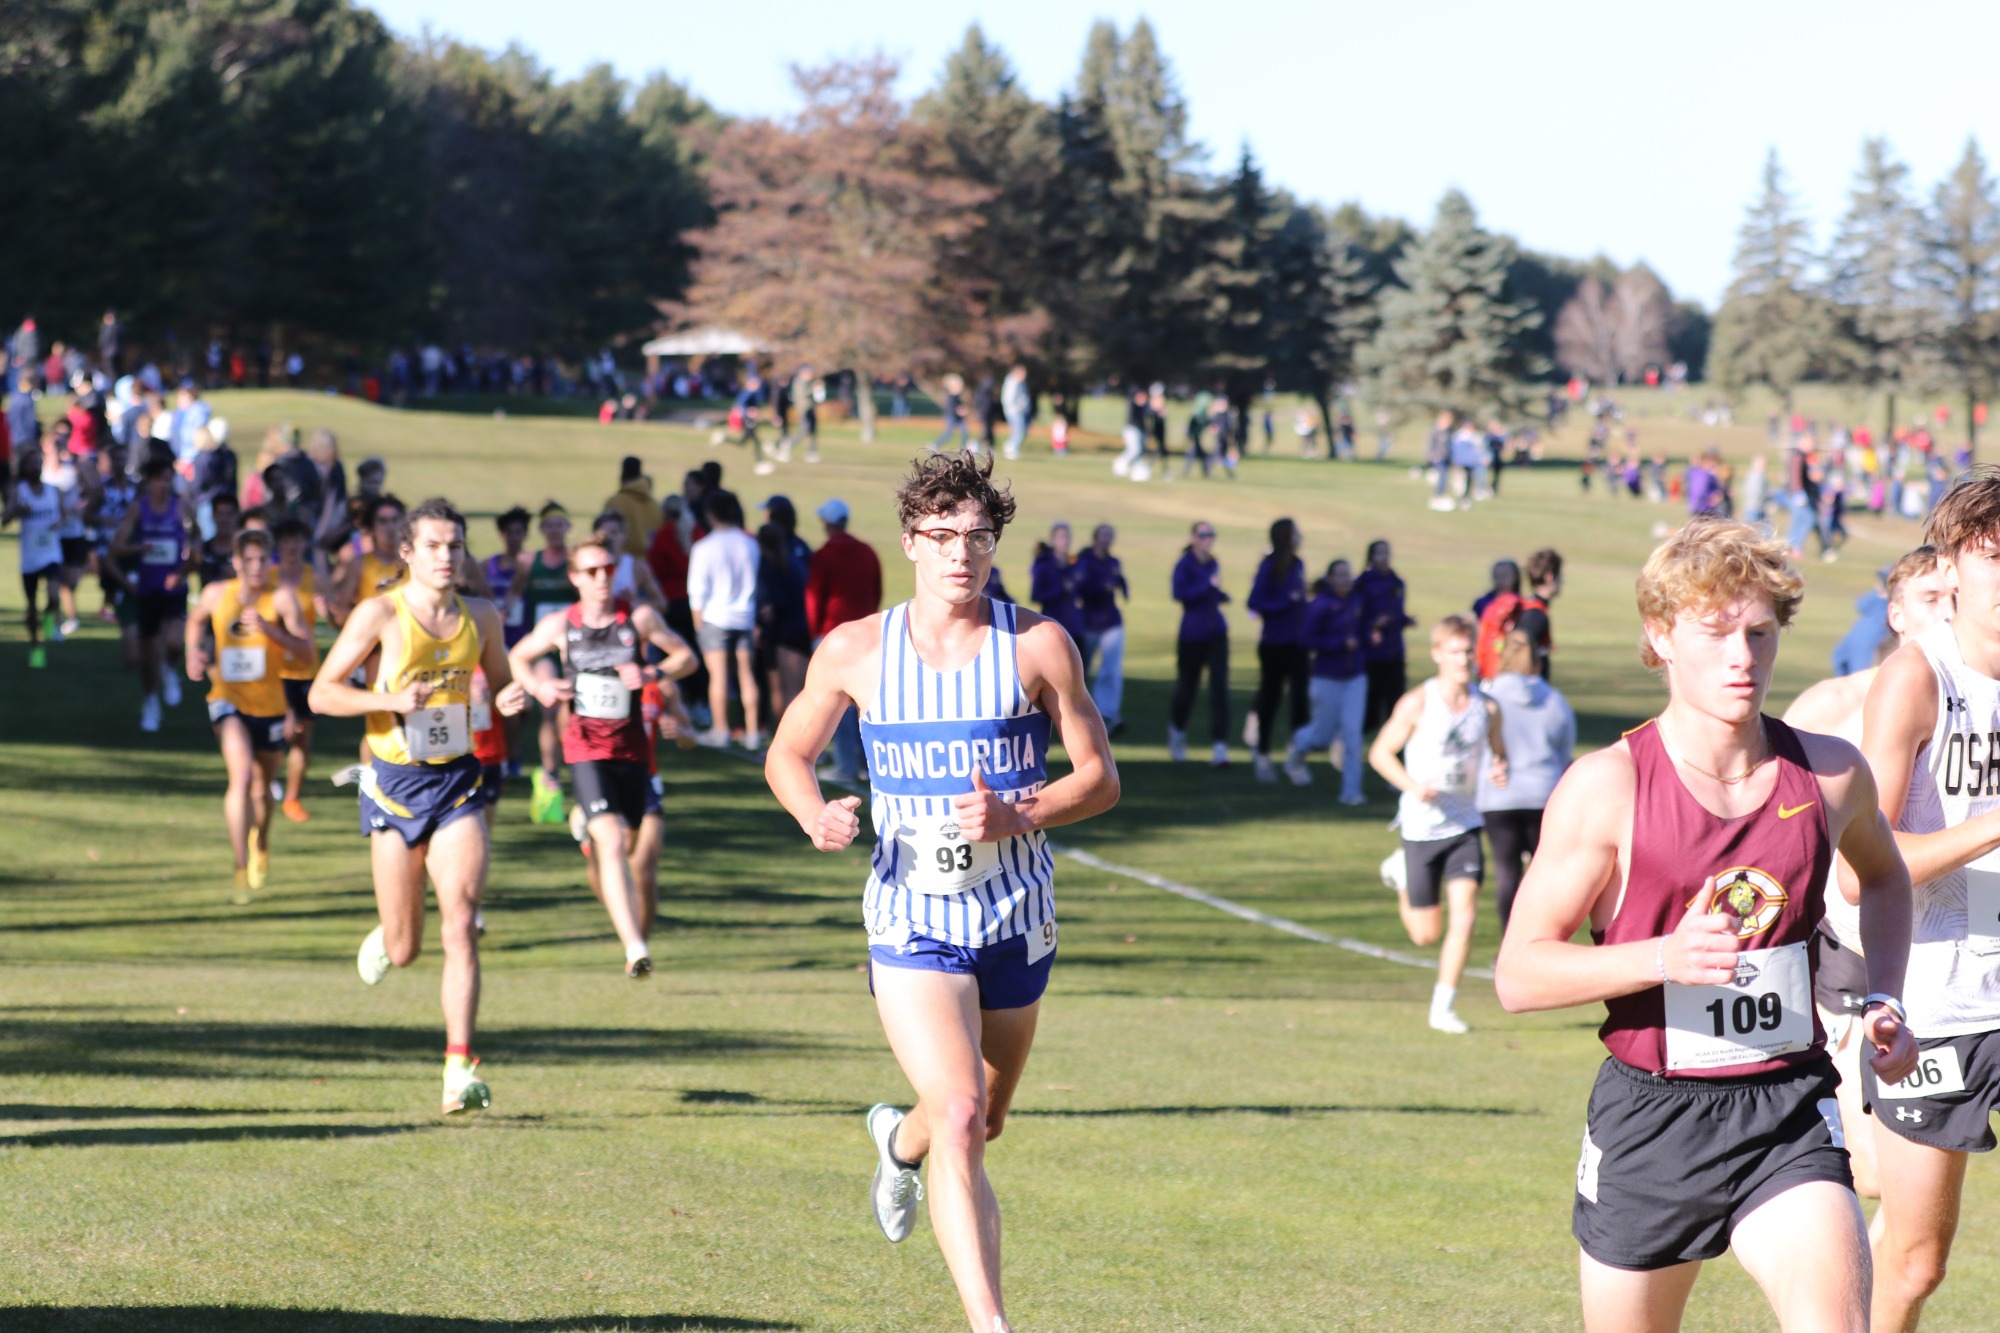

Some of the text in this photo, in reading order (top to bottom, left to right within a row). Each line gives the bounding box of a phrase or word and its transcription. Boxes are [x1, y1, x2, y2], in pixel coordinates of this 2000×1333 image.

[428, 726, 449, 745] 55
[872, 733, 1035, 779] CONCORDIA
[936, 844, 973, 873] 93
[1706, 992, 1782, 1037] 109
